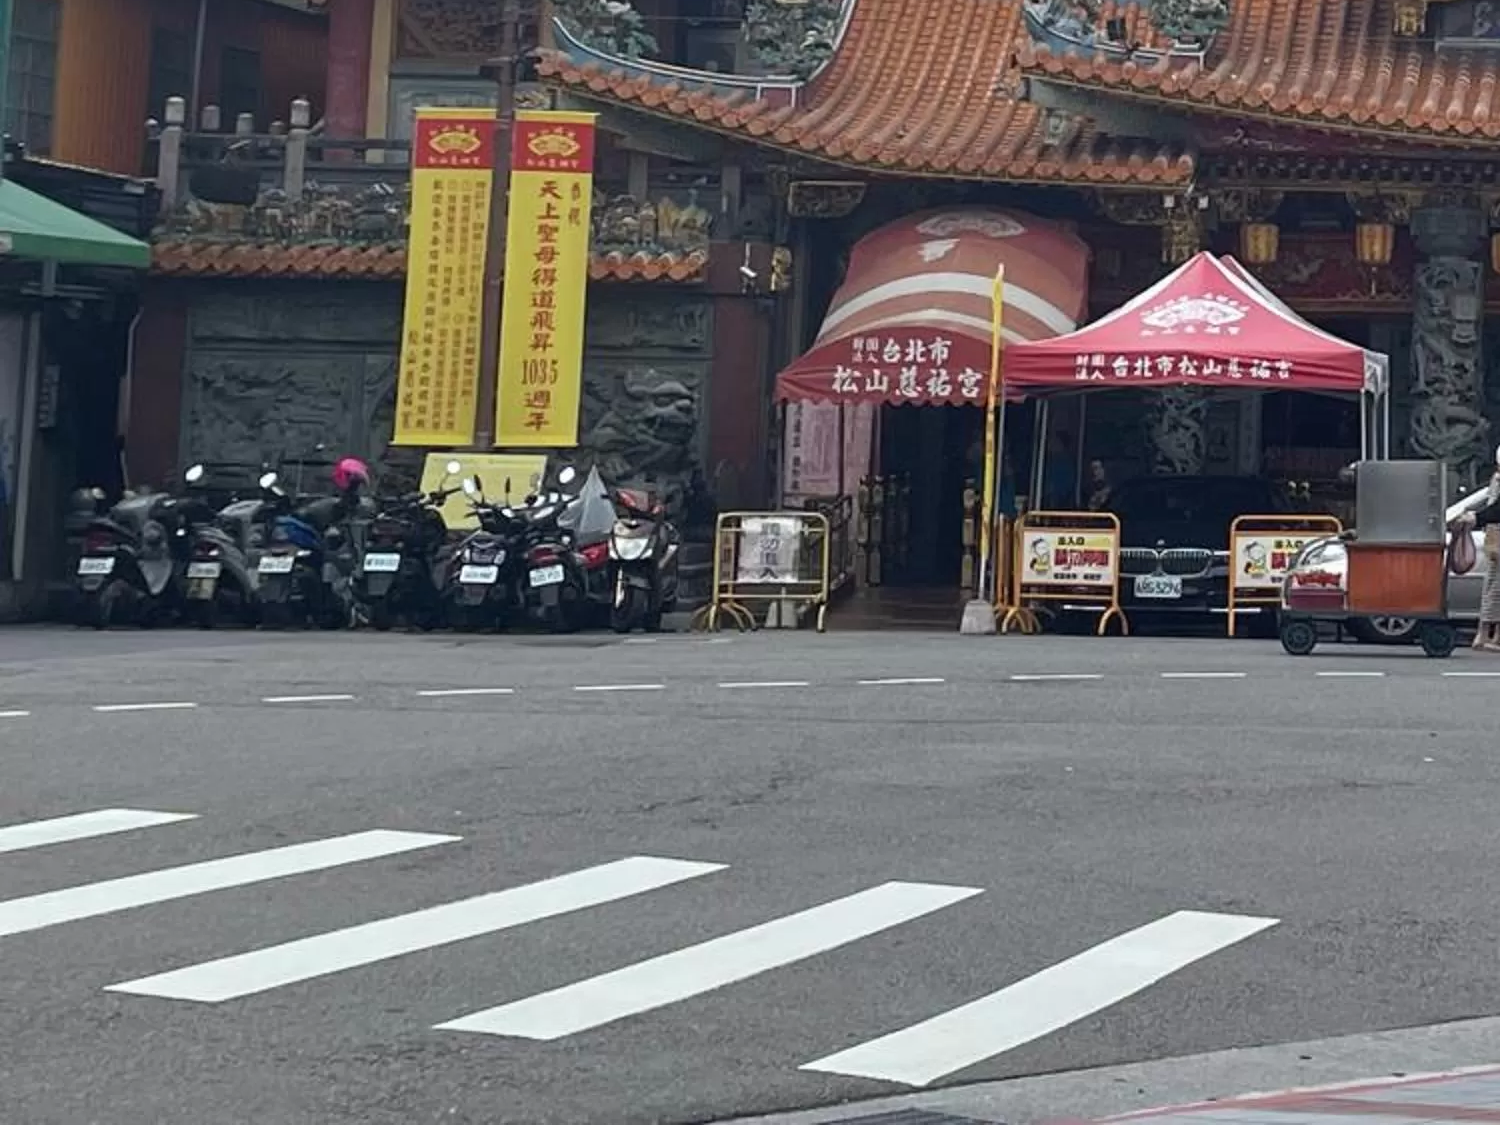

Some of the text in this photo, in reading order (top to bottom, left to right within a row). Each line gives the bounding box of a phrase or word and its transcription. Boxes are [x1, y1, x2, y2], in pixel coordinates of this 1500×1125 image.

[883, 336, 952, 366] 台北市
[831, 365, 983, 398] 松山慈祐宮
